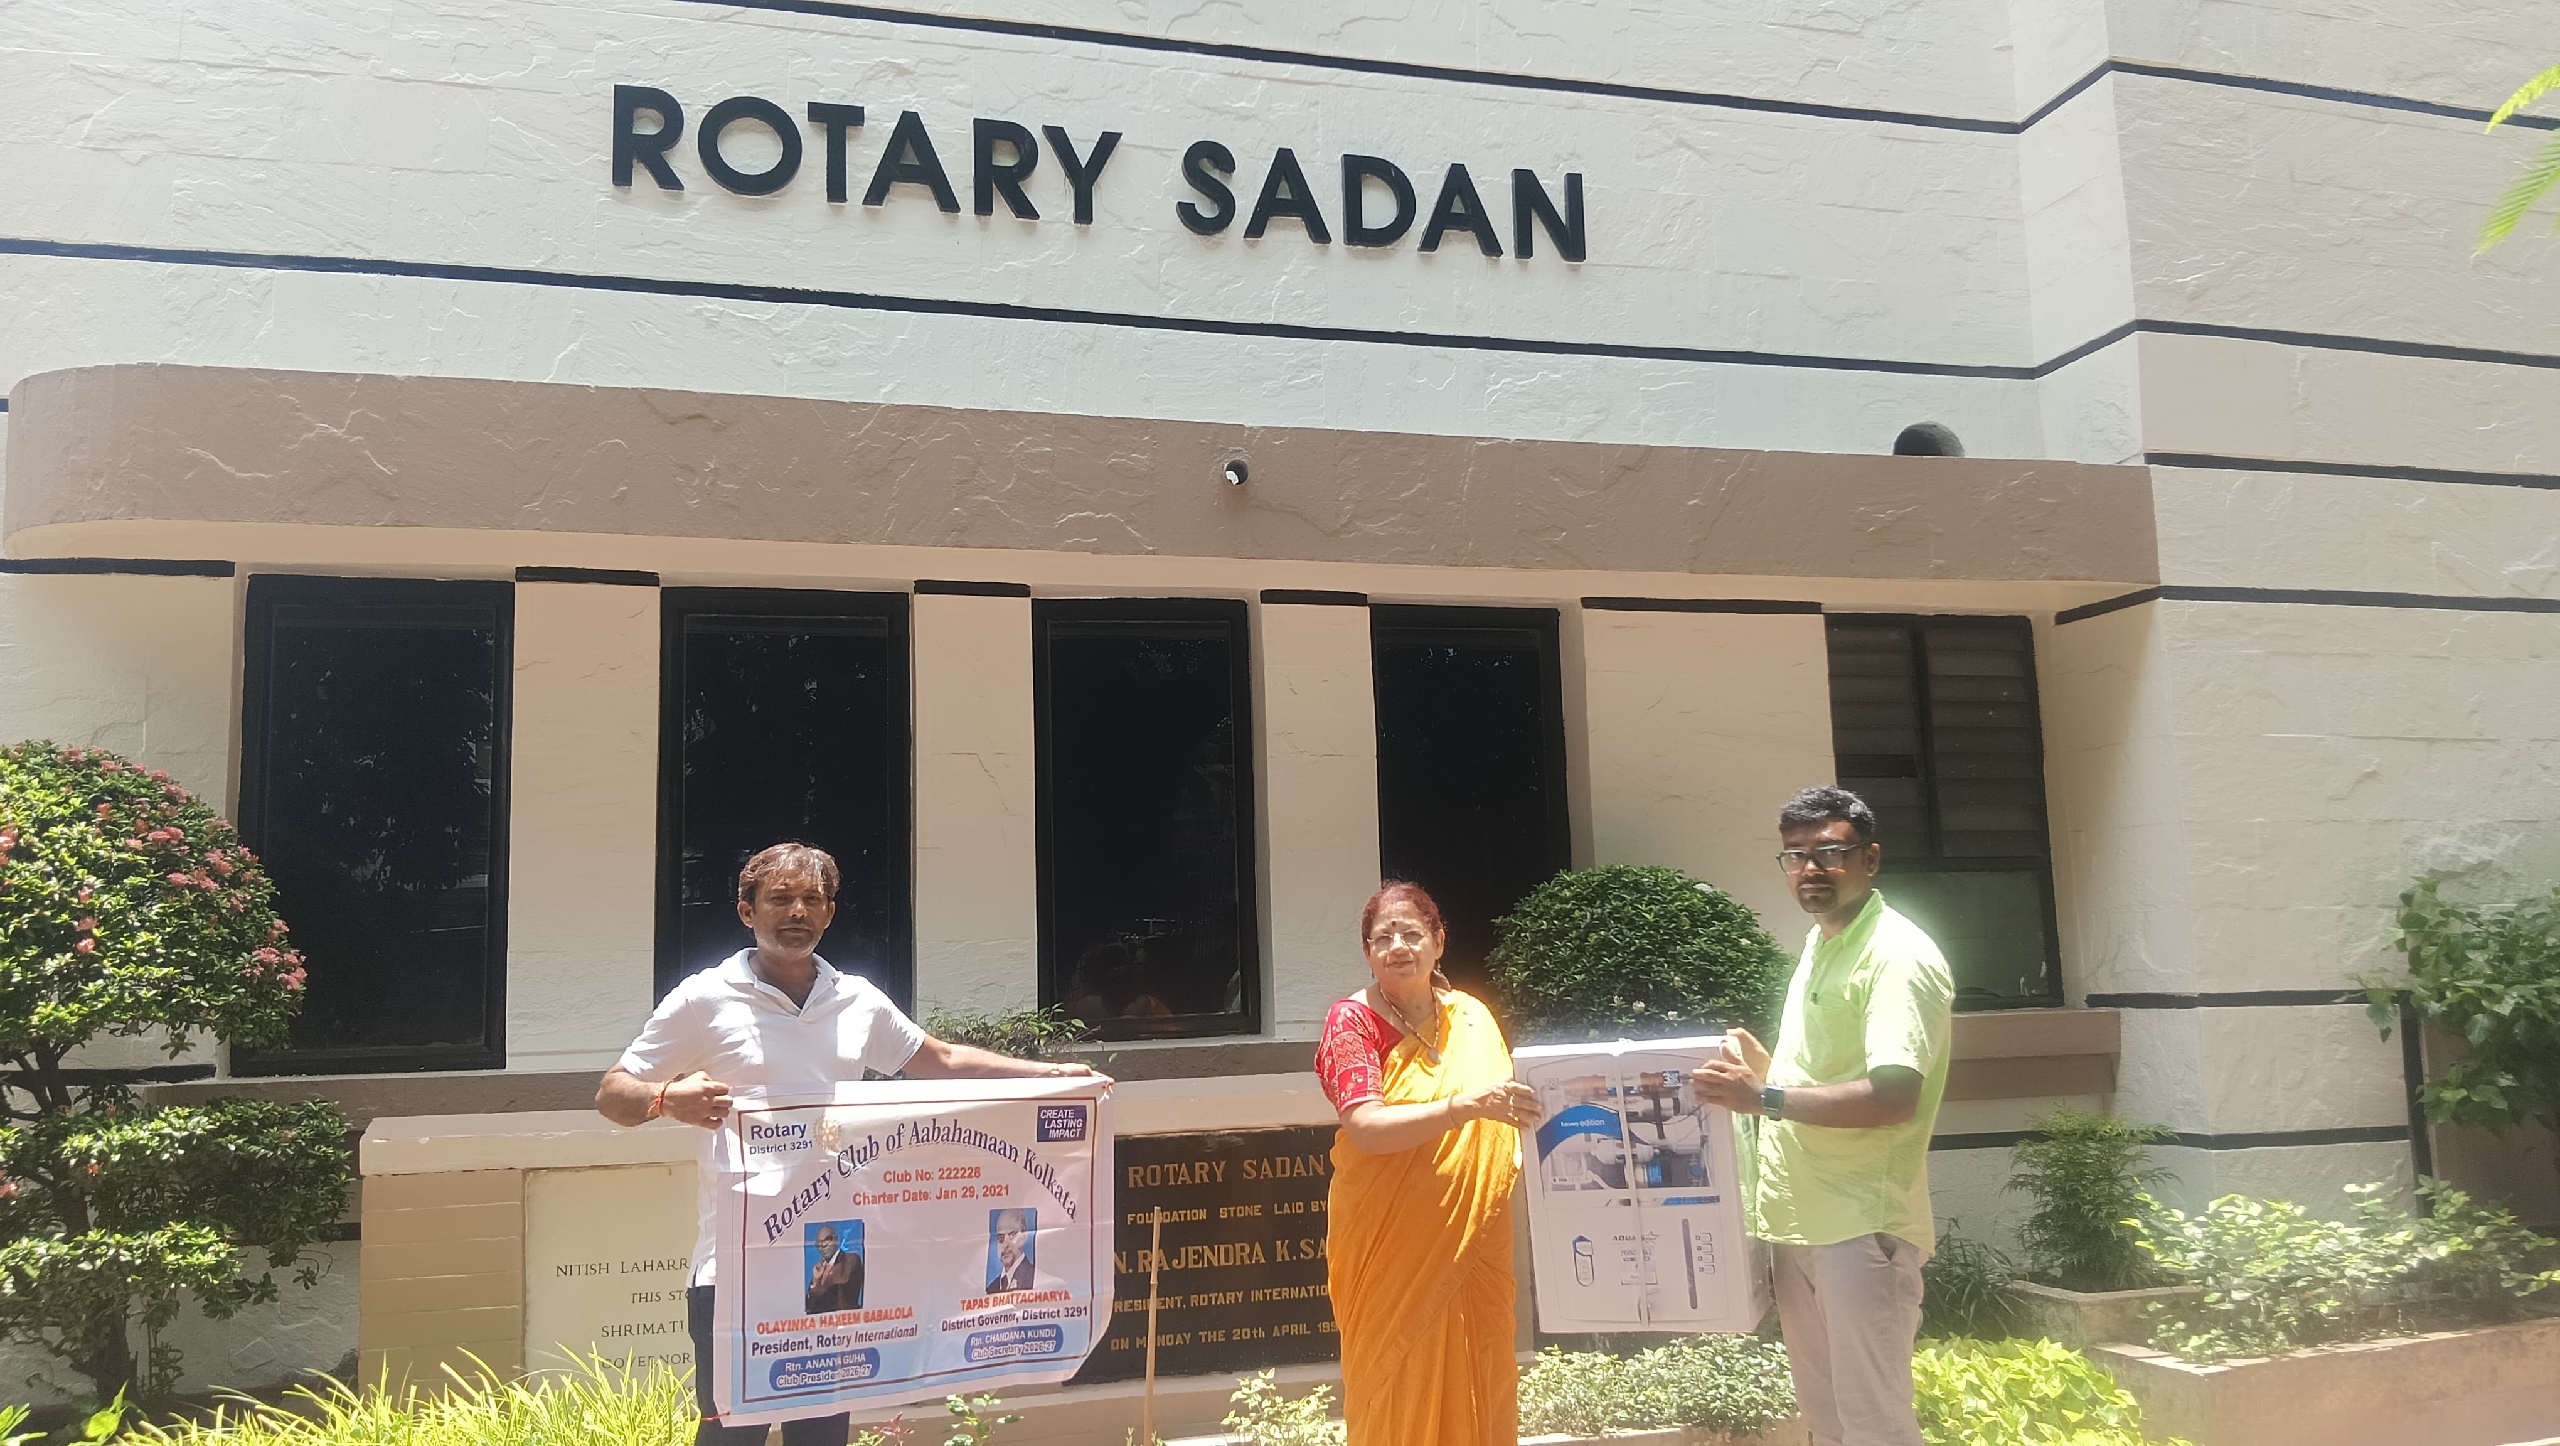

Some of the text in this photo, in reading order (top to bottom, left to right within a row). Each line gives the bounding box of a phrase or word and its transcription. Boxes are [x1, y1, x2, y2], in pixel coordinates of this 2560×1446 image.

[613, 84, 1586, 263] ROTARY SADAN
[1040, 1109, 1075, 1119] CREATE
[750, 1123, 807, 1140] Rotary
[1045, 1119, 1083, 1129] LASTING
[1049, 1129, 1081, 1139] IMPACT
[749, 1140, 813, 1155] District 3291
[763, 1118, 1077, 1243] Rotary Club of Aabahamaan Kolkata
[883, 1166, 981, 1183] Club No: 222228
[1127, 1154, 1325, 1188] ROTARY SADAN
[853, 1184, 1009, 1206] Charter Date: Jan 29, 2021
[1127, 1200, 1327, 1225] FOUDATION STONE LAID BY
[556, 1258, 690, 1277] NITISH LAHARR
[631, 1291, 662, 1304] THIS
[960, 1290, 1071, 1311] TAPAS BHATTACHARYA
[1114, 1296, 1187, 1313] RESIENT,
[1190, 1291, 1244, 1308] ROTARY
[757, 1318, 816, 1335] OLAYINKA
[863, 1305, 913, 1323] BABALOLA
[941, 1306, 1088, 1332] District Governor, District 3291
[601, 1320, 684, 1338] SHRIMATI
[985, 1331, 1026, 1344] CHANDANA
[1027, 1328, 1057, 1339] KUNDU
[1111, 1337, 1129, 1351] ON
[1136, 1332, 1191, 1349] MNDAY
[1199, 1330, 1226, 1343] THE
[1232, 1327, 1265, 1341] 20th
[1273, 1323, 1311, 1338] APRIL
[752, 1324, 918, 1356] President, Rotary International
[972, 1346, 989, 1360] Club
[989, 1343, 1023, 1359] Secretary
[785, 1353, 866, 1372] Rtn. ANANYA GUHA
[777, 1374, 799, 1387] Club
